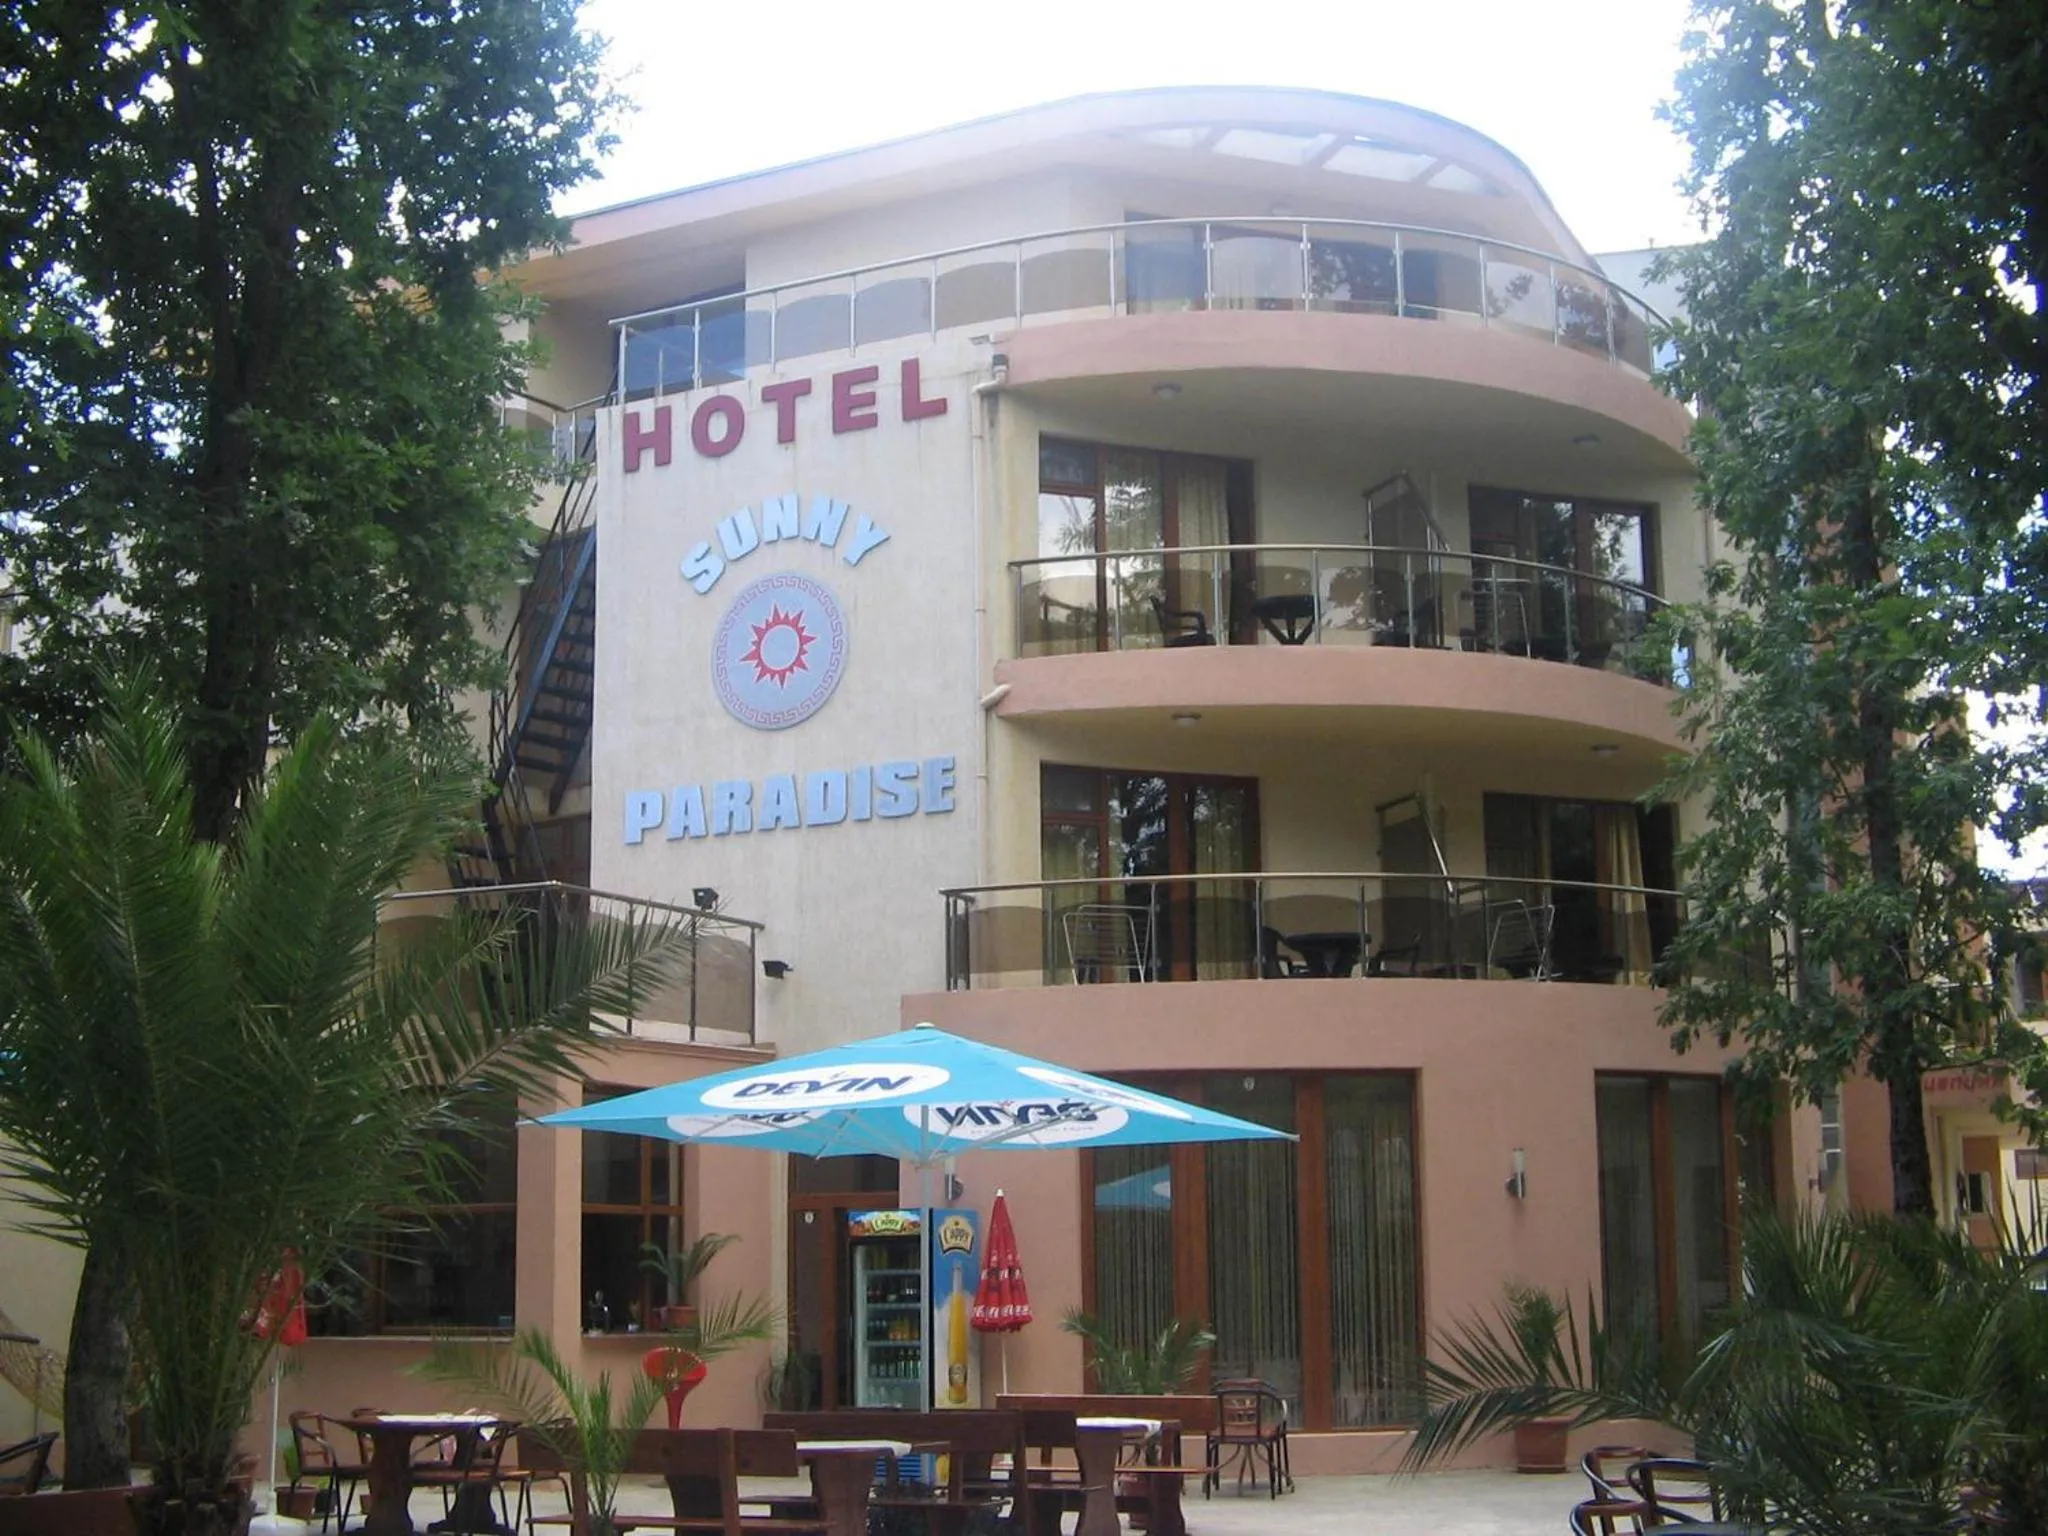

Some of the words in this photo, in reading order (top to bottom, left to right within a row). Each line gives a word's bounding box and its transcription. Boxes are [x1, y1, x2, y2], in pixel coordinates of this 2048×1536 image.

[622, 357, 949, 473] HOTEL
[680, 492, 891, 595] SUNNY
[624, 756, 956, 845] PARADISE
[733, 1075, 913, 1098] DEVIN
